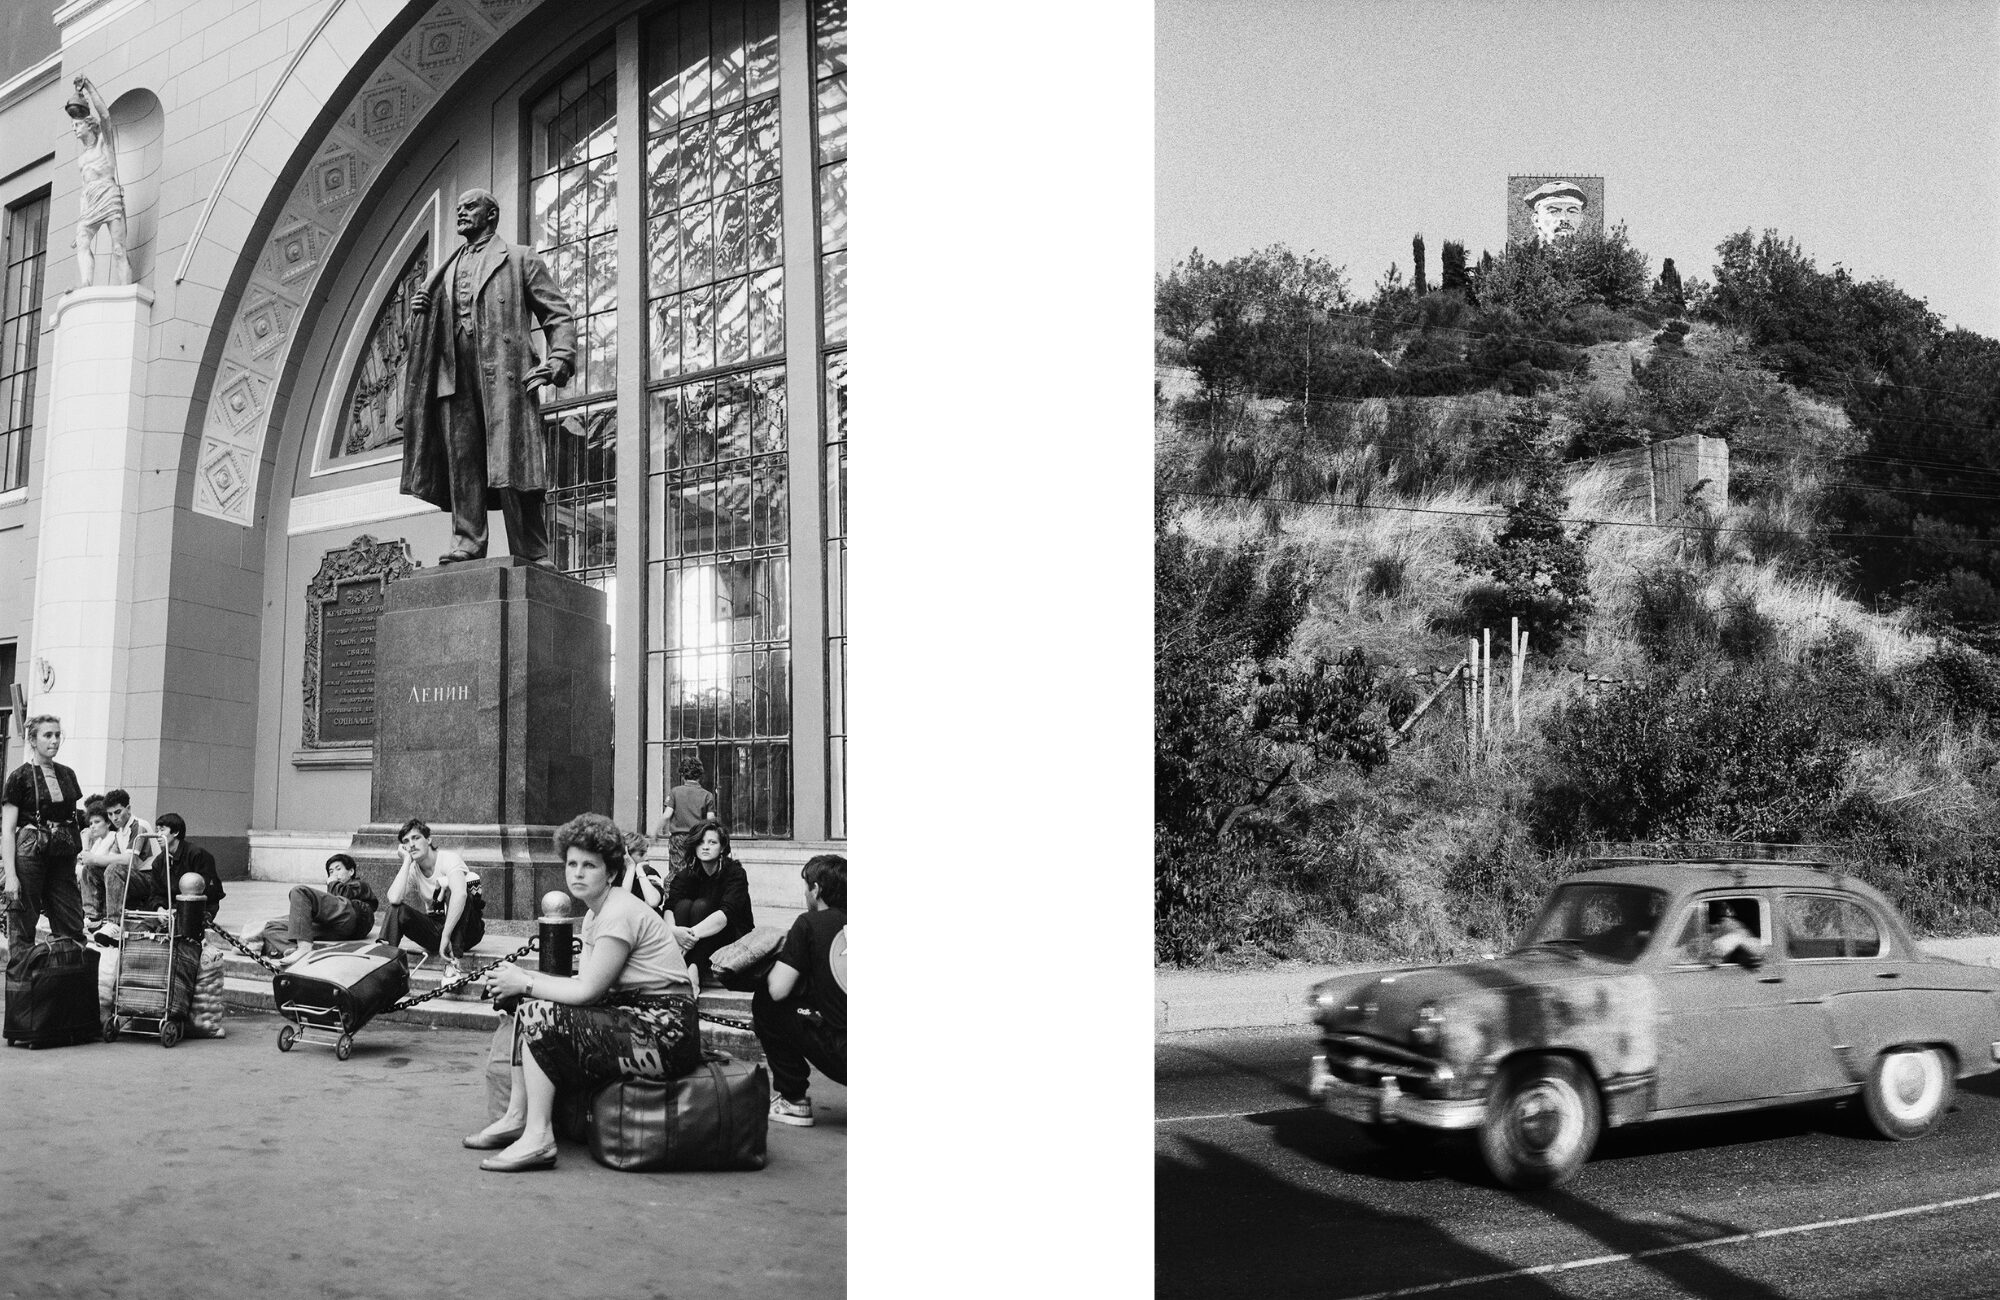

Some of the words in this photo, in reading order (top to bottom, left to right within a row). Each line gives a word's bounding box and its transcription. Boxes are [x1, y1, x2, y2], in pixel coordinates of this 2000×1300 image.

[366, 605, 384, 614] ДОРО
[360, 637, 376, 645] ЯРК
[408, 684, 468, 703] ЛЕНИН
